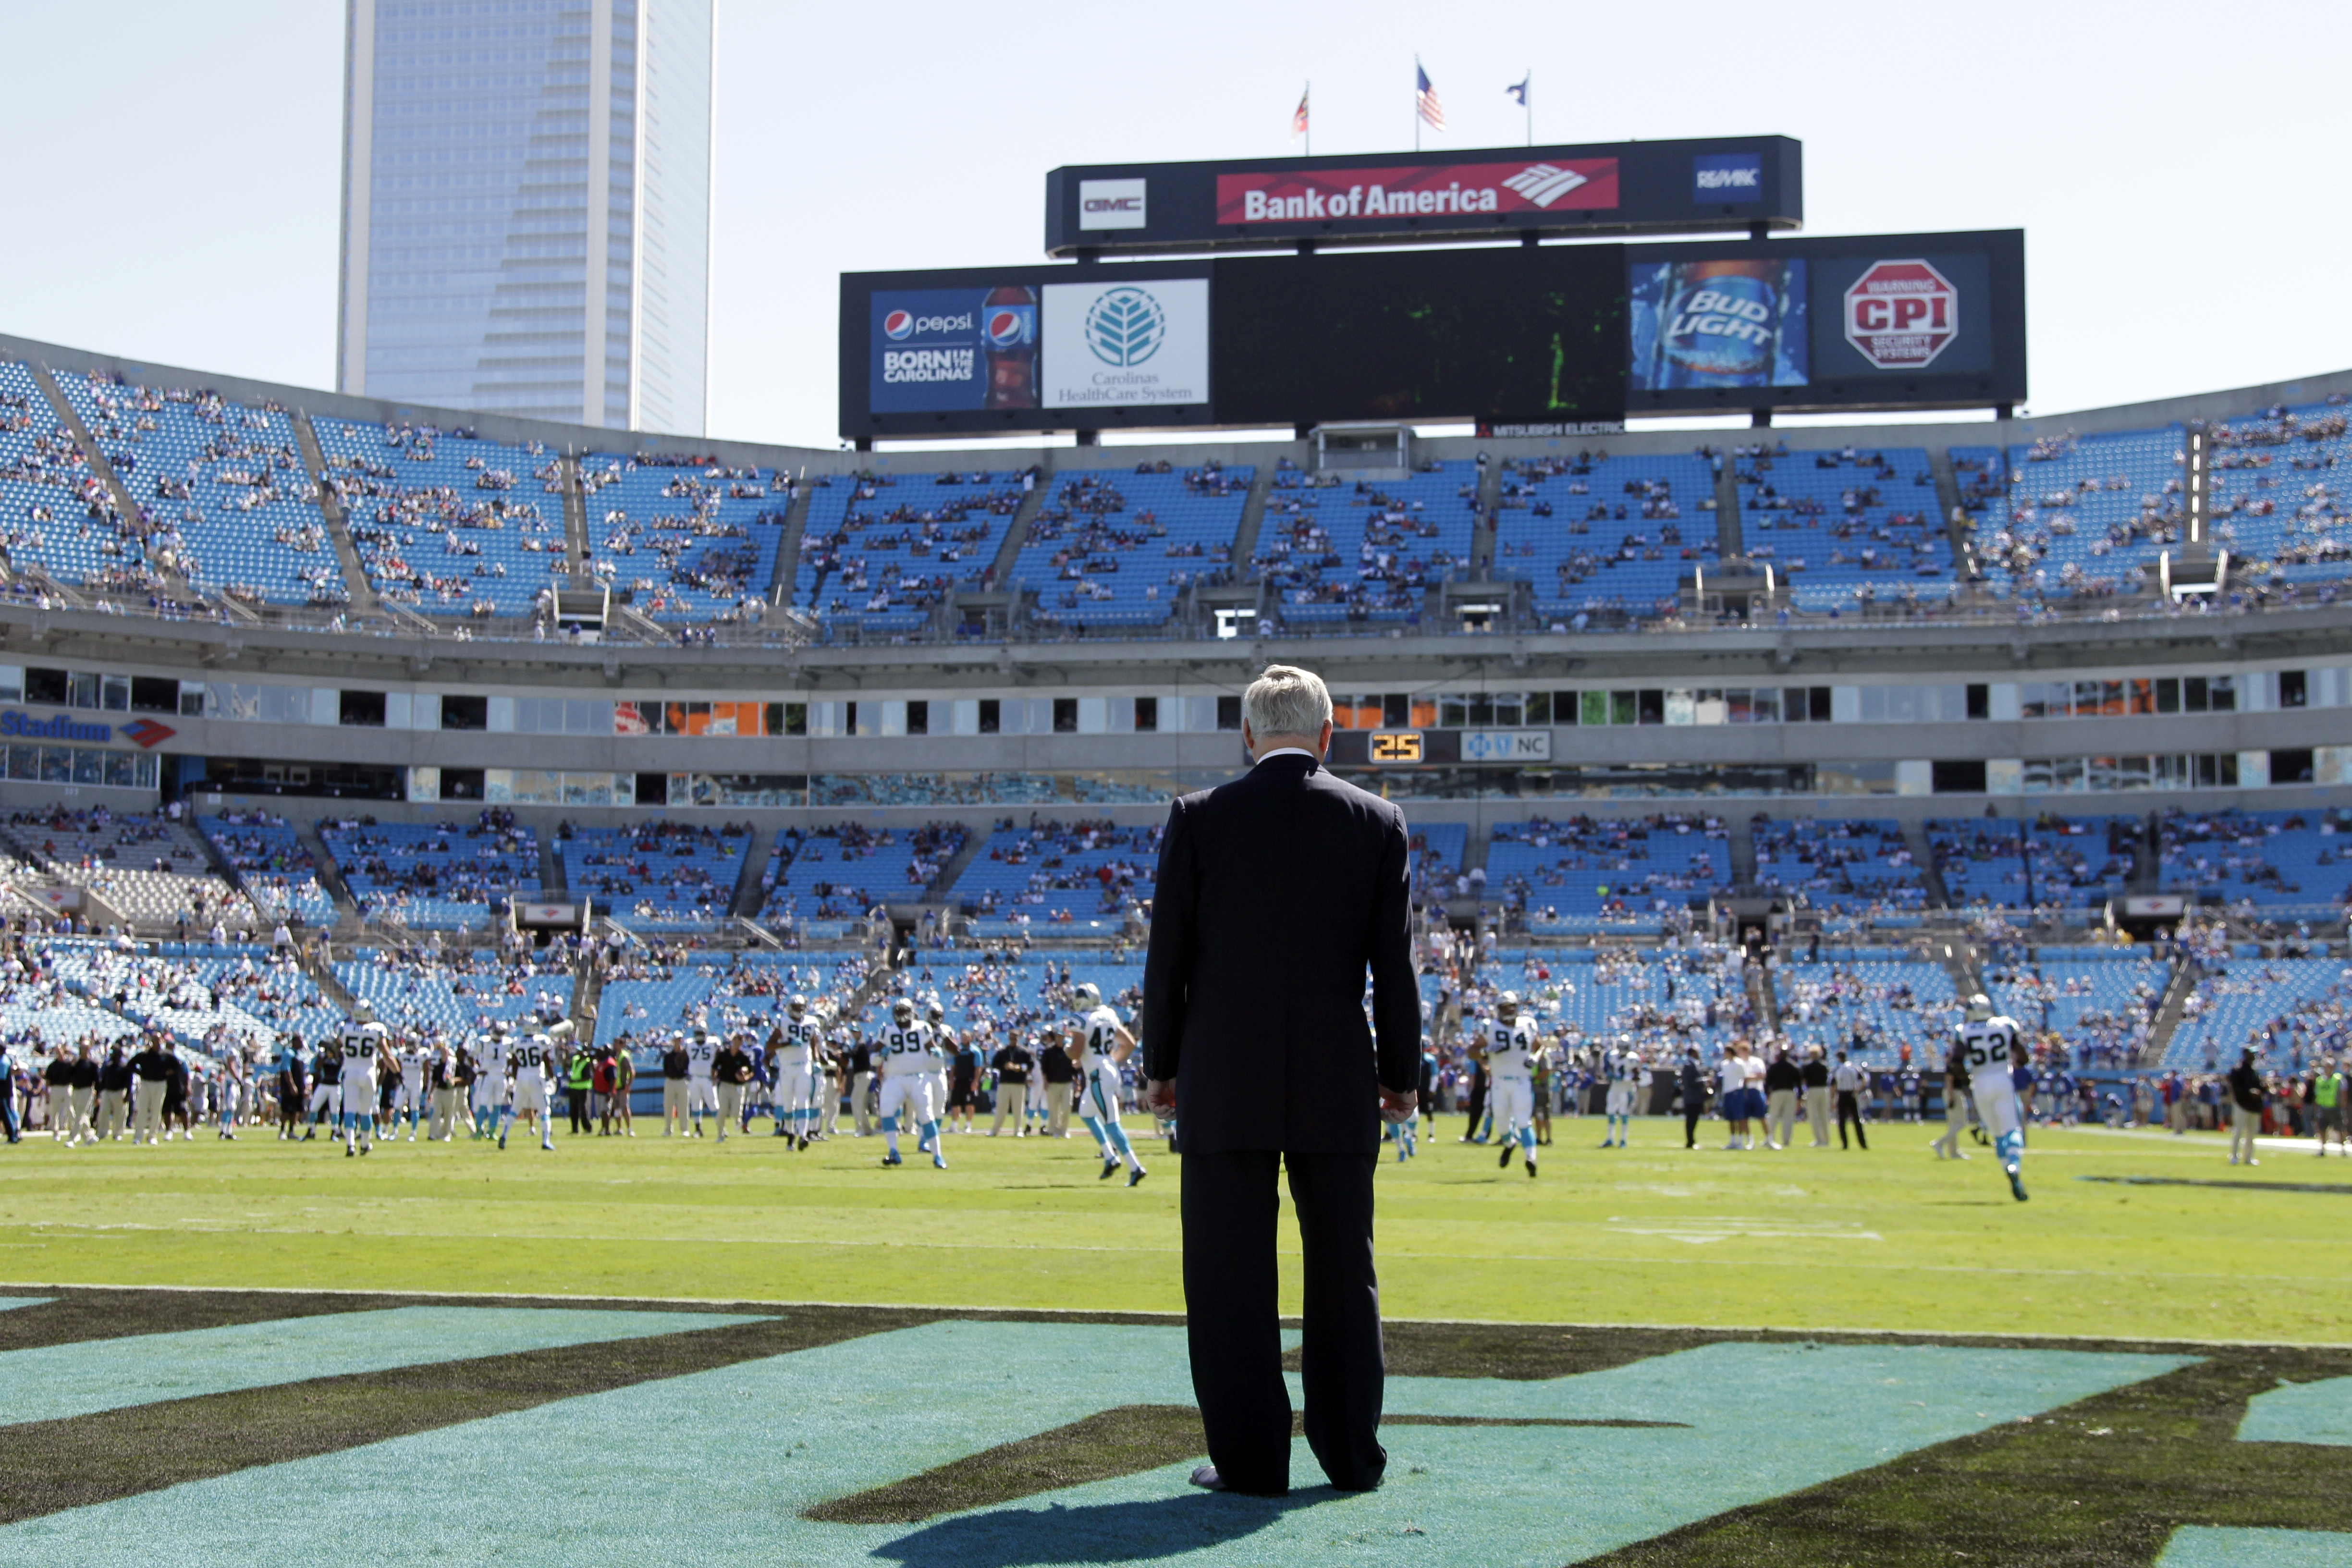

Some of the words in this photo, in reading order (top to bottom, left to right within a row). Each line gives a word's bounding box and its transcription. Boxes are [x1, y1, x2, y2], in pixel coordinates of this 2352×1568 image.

[1085, 196, 1141, 212] GMC
[1245, 187, 1325, 220] Bank
[1328, 185, 1362, 217] of
[1364, 181, 1497, 215] America
[1866, 279, 1936, 294] WARNING
[1685, 290, 1769, 323] BUD
[1856, 297, 1947, 331] CPI
[915, 312, 973, 334] pepsi
[1668, 313, 1773, 345] LIGHT
[1871, 335, 1932, 349] SECURITY
[884, 349, 953, 370] BORN
[953, 348, 974, 359] IN
[954, 359, 973, 368] THE
[1873, 347, 1932, 359] SYSTEMS
[883, 368, 973, 383] CAROLINAS
[1091, 371, 1159, 385] Carolinas
[1058, 386, 1138, 402] HealthCare
[1141, 385, 1192, 403] System
[1565, 421, 1624, 436] ELECTRIC
[1, 710, 111, 743] Stadium
[1372, 734, 1420, 761] 25
[1518, 737, 1544, 753] NC
[345, 1036, 375, 1058] 56
[890, 1032, 920, 1054] 99
[1495, 1030, 1527, 1054] 94
[1968, 1033, 2007, 1065] 52
[516, 1046, 541, 1067] 36
[691, 1047, 710, 1060] 75
